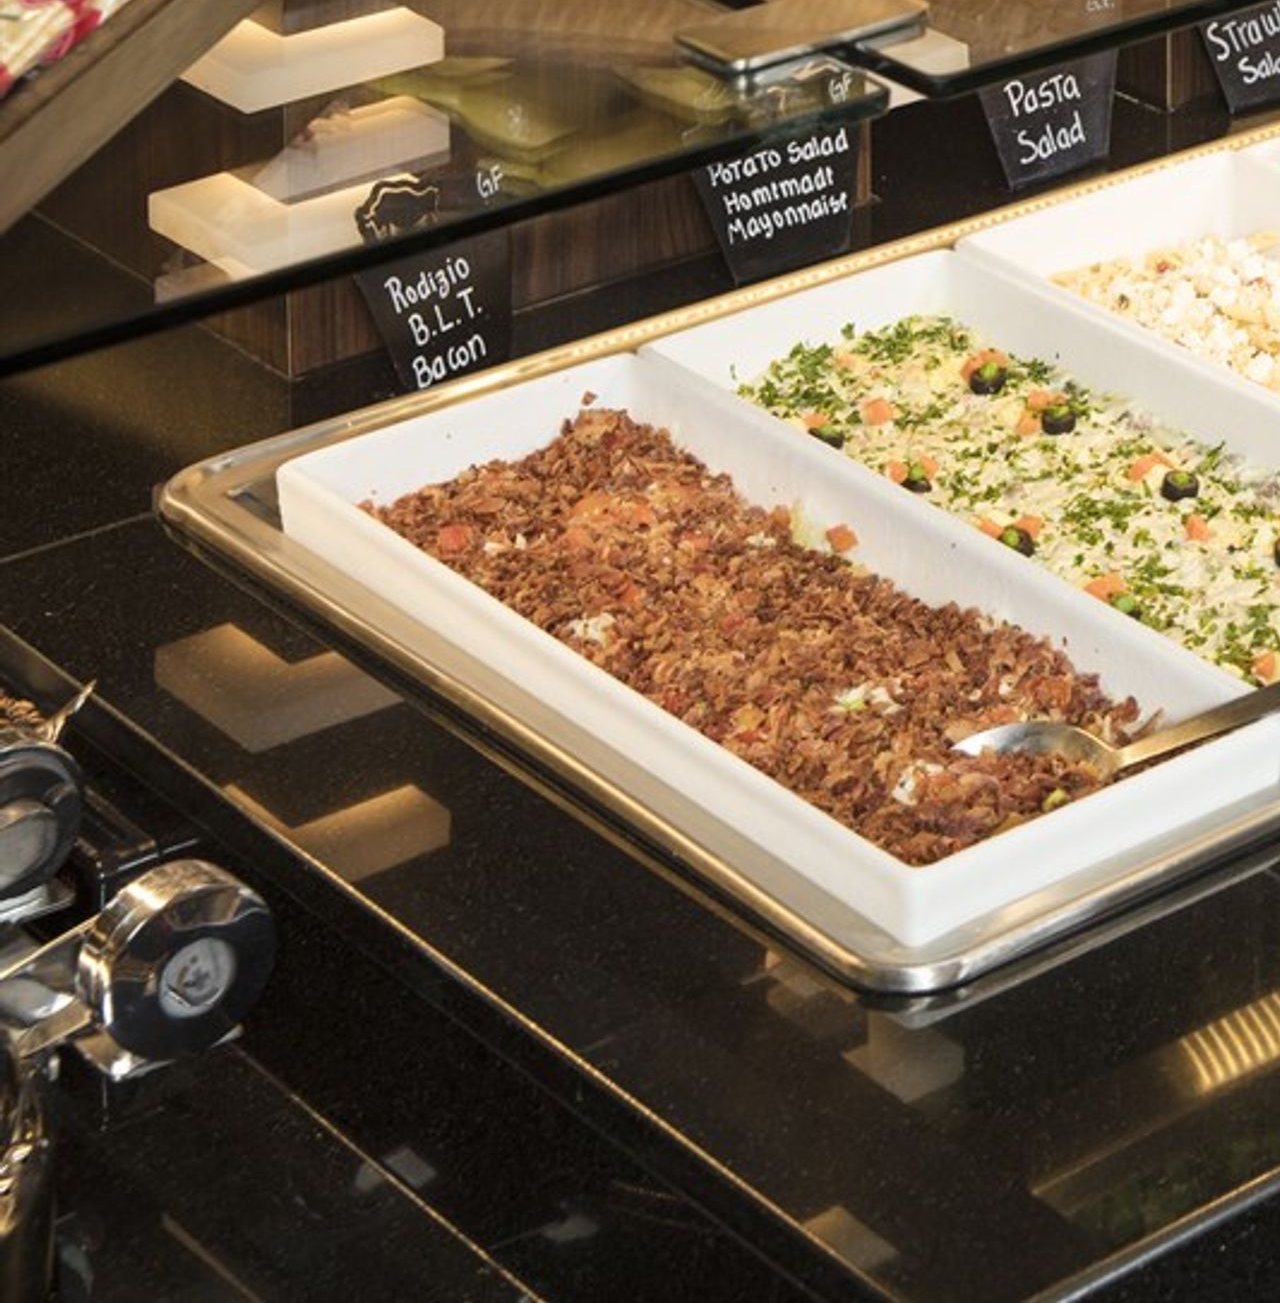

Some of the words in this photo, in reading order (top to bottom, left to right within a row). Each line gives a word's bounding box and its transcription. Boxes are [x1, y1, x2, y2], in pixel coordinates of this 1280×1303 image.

[787, 127, 849, 166] Salad
[1017, 109, 1087, 165] Salad
[383, 256, 471, 314] Rodizio
[411, 332, 488, 389] Bacon
